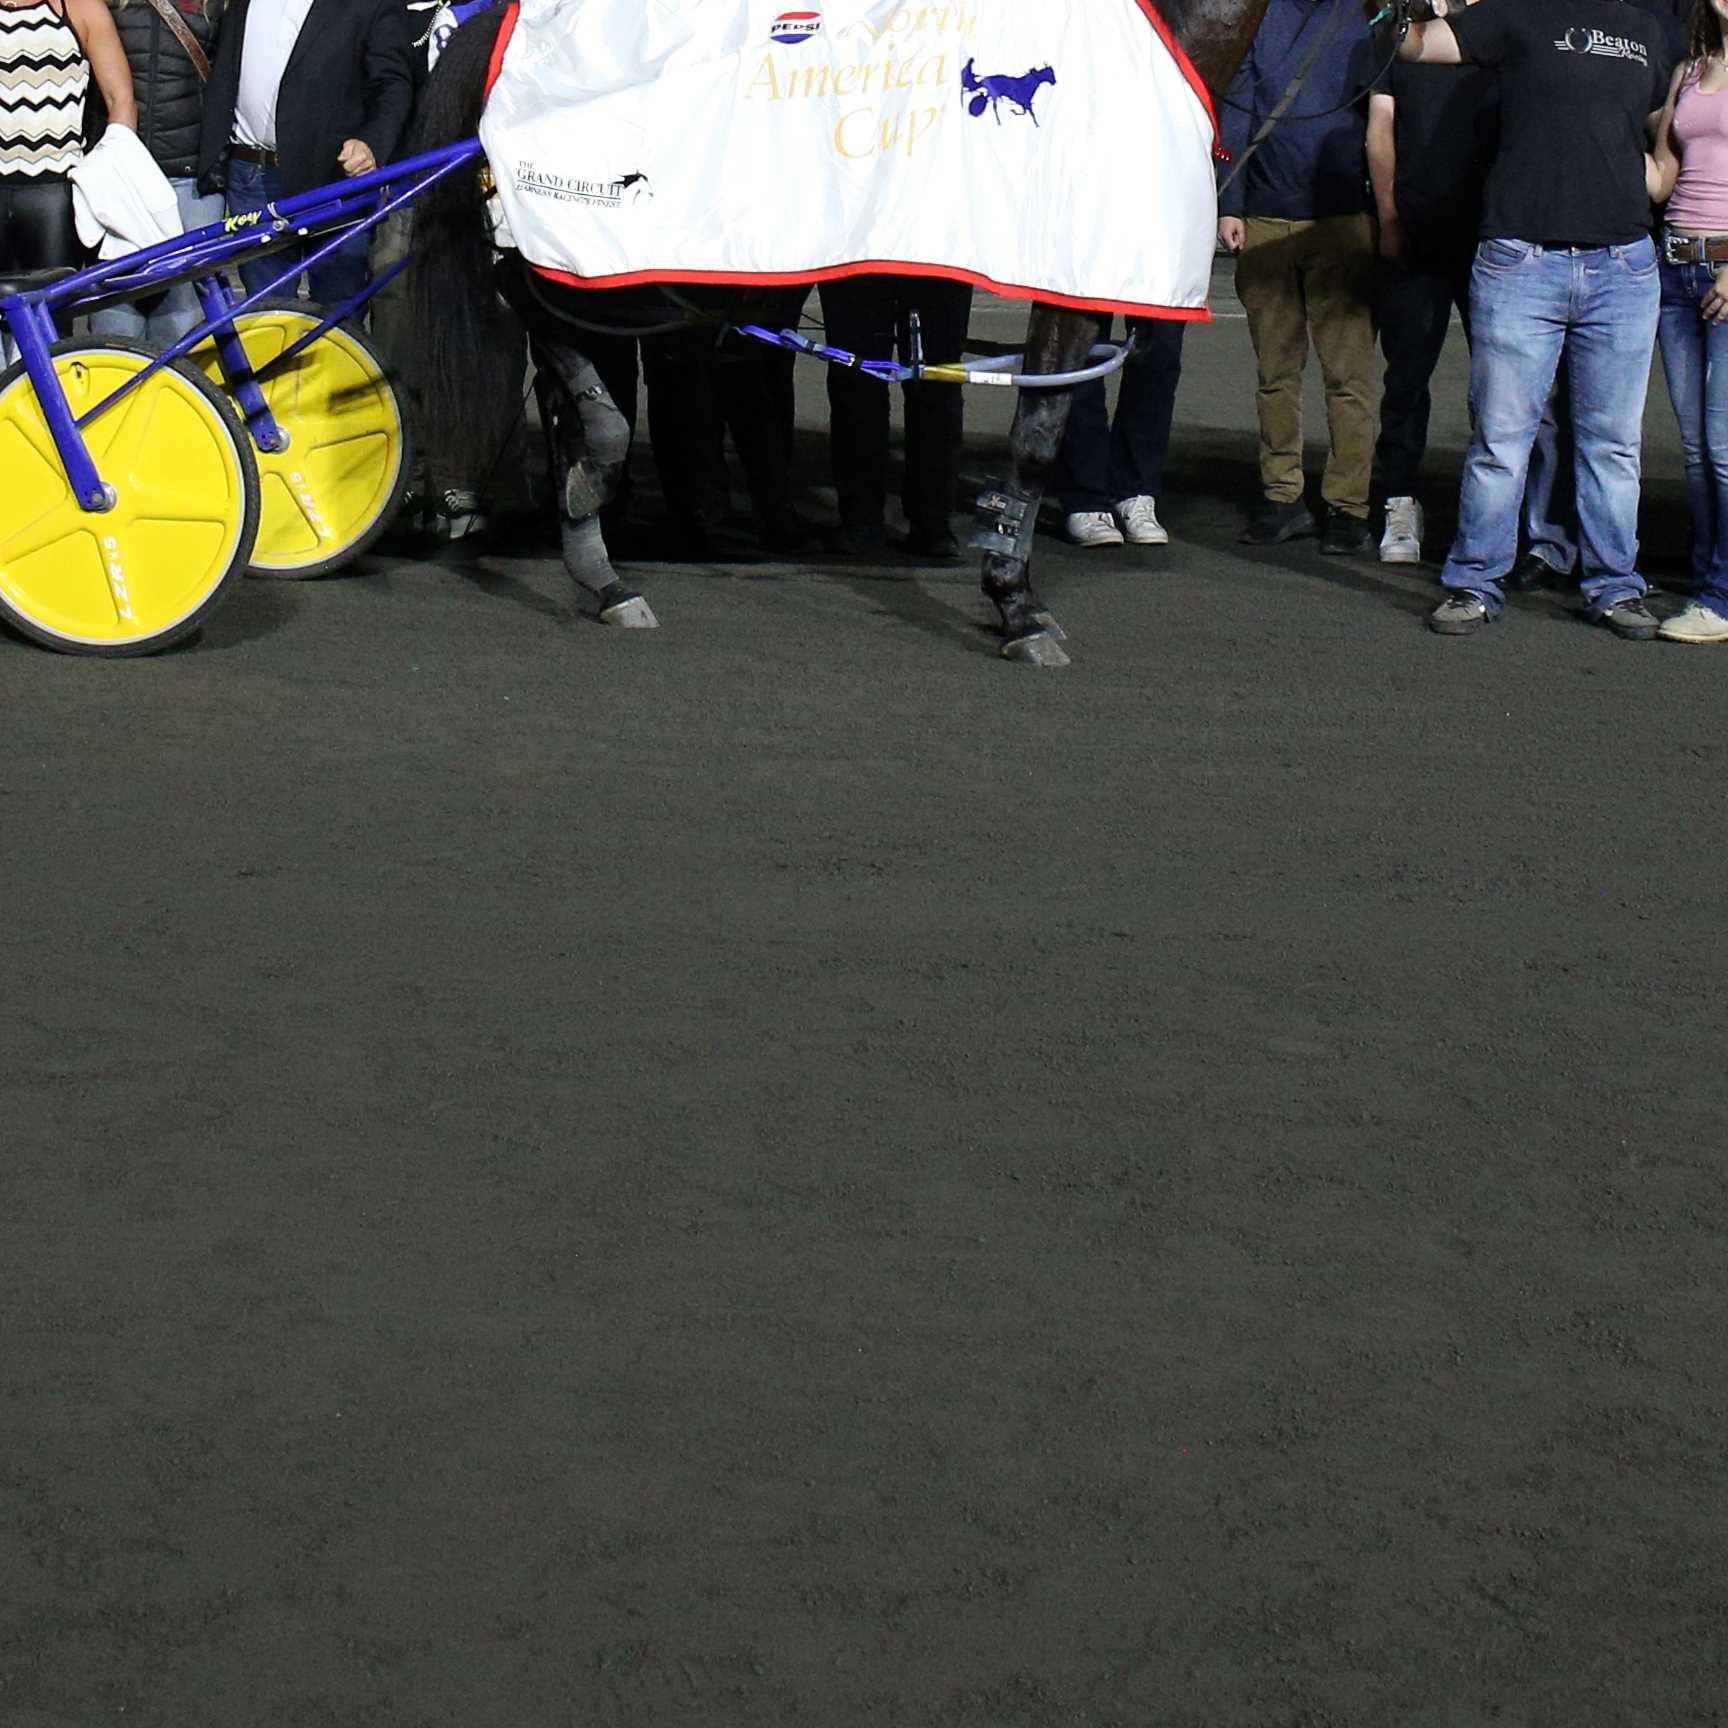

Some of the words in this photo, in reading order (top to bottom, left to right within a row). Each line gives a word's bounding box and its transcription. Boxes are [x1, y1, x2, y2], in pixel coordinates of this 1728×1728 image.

[771, 22, 821, 33] PEPSI
[1592, 29, 1648, 57] Beaton
[742, 42, 947, 102] America
[833, 106, 938, 159] Cup
[517, 168, 564, 187] GRAND
[567, 179, 622, 198] CIRCUIT
